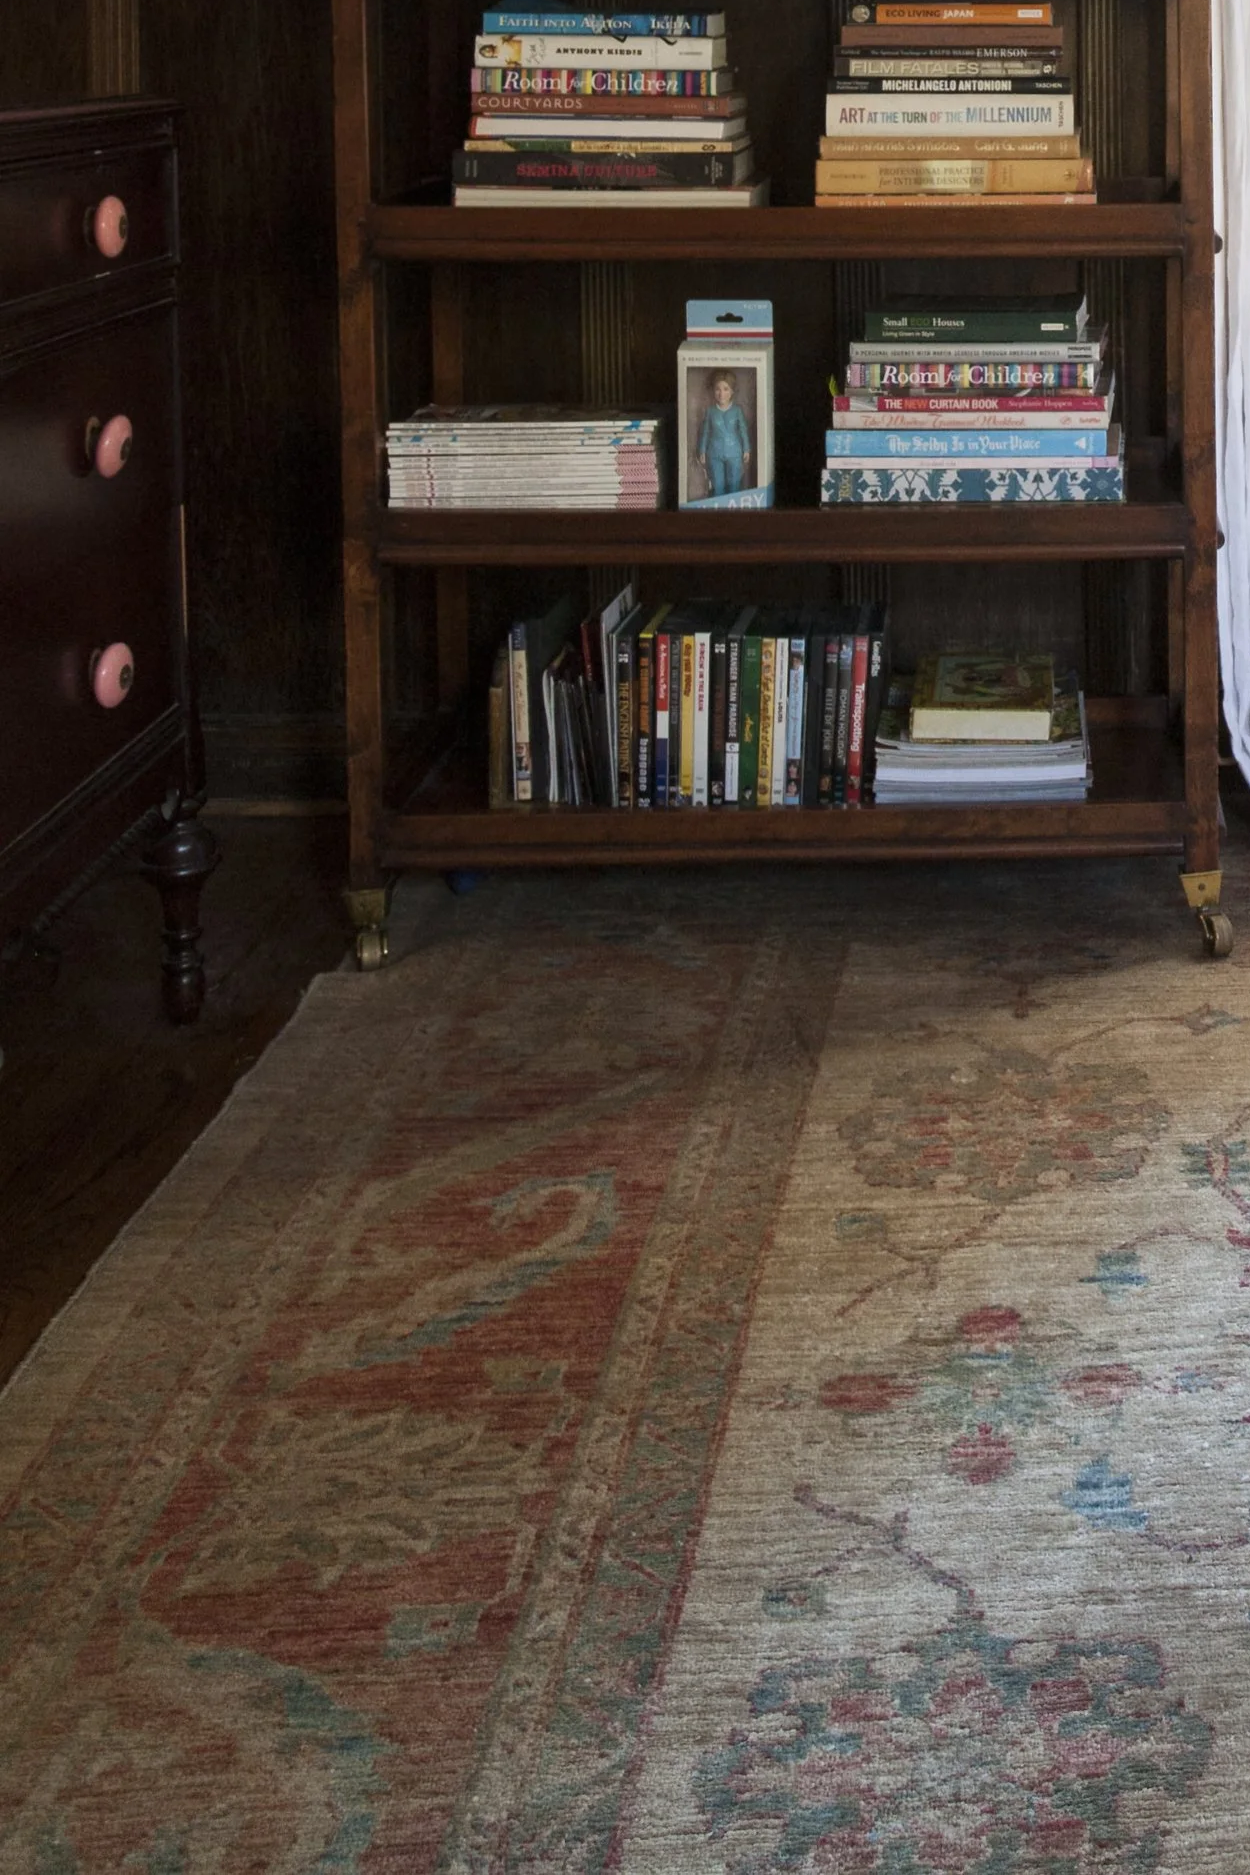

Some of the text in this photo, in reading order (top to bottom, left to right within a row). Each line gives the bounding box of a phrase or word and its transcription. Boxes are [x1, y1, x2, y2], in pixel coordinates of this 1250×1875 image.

[886, 9, 975, 19] ECO LIVING JAPAN
[499, 16, 632, 29] FAITH INTO ACTION
[555, 48, 643, 56] ANTHONY KIEDIS
[976, 47, 1028, 58] EMERSON
[851, 60, 895, 75] FILM
[900, 60, 980, 75] FATALES
[503, 70, 561, 91] Room
[590, 71, 679, 92] Children
[882, 79, 957, 92] MICHELANGELO
[957, 79, 1012, 92] ANTONIONI
[478, 97, 583, 110] COURTYARDS
[839, 106, 1052, 124] ART AT THE TURN OF THE MILLENNIUM
[1057, 100, 1065, 127] TASCHEN
[516, 164, 578, 177] SEMINA
[879, 167, 985, 175] PROFESSIONAL PRACTICE
[879, 177, 985, 187] for INTERIOR DESIGNERS
[882, 317, 908, 327] Small
[932, 317, 966, 327] Houses
[881, 366, 940, 385] Room
[967, 365, 1055, 385] Children
[884, 399, 998, 410] THE NEW CURTAIN BOOK
[885, 434, 1041, 454] The Selby Is in Your Place
[728, 642, 738, 738] STRANGER THAN PARADISE
[824, 688, 836, 713] BELLE
[823, 714, 835, 726] DE
[836, 688, 848, 759] ROMAN HOLIDAY
[850, 682, 866, 752] Trainspotting
[619, 681, 630, 774] THE ENGLISH PATIENT
